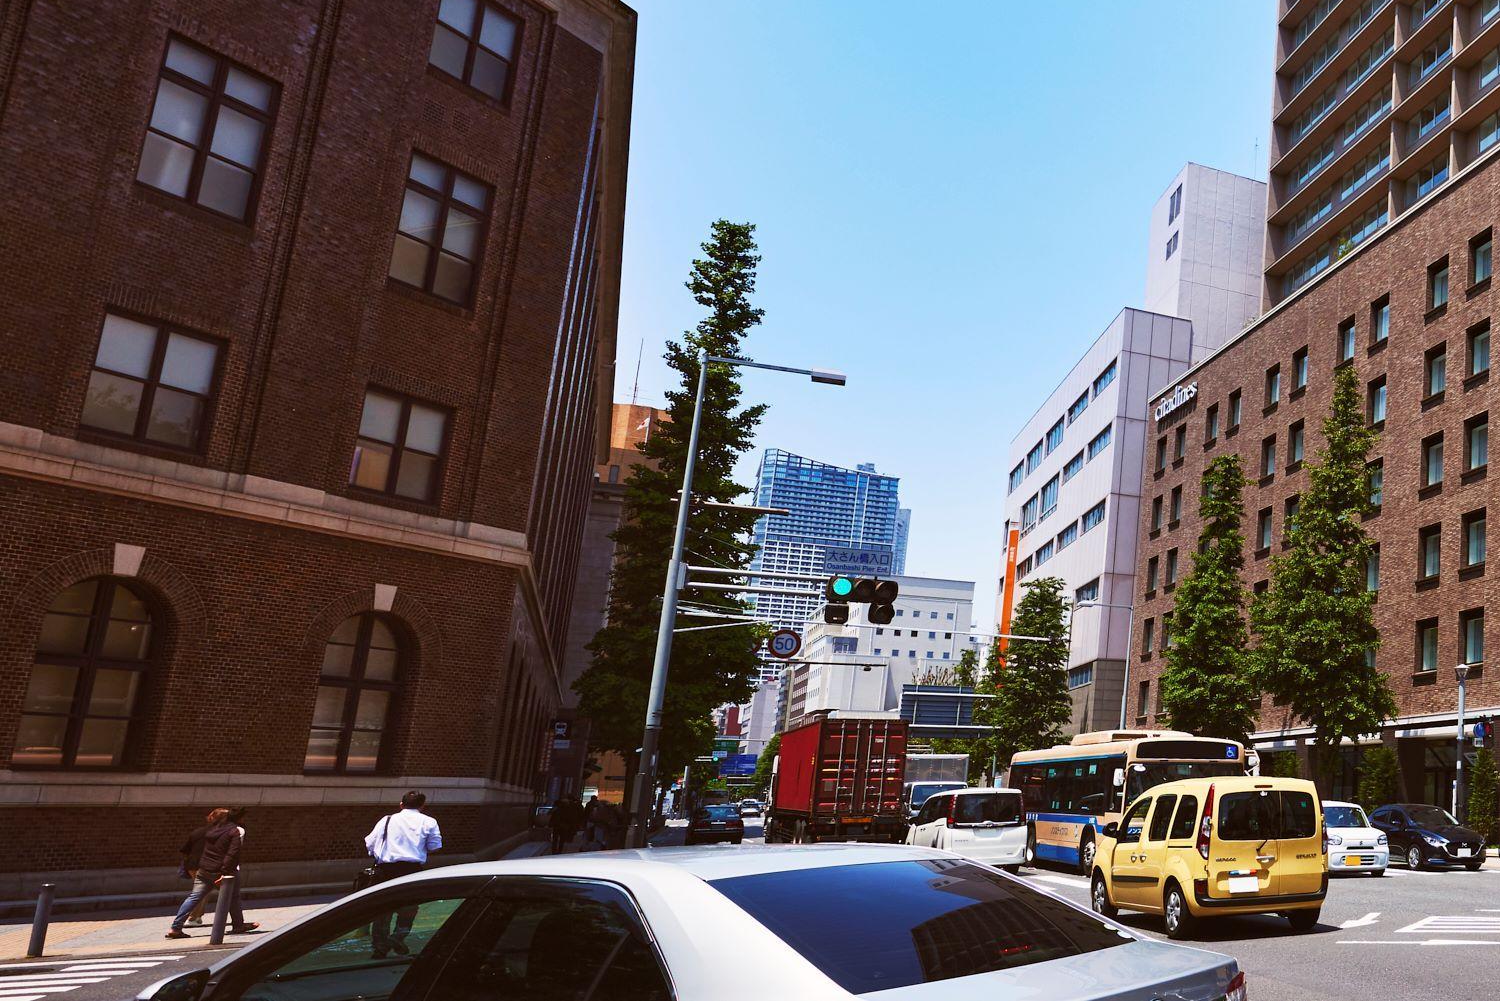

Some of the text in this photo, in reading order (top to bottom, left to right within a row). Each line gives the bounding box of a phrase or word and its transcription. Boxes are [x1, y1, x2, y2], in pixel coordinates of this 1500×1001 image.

[828, 551, 890, 565] 大さん橋入口
[827, 563, 860, 571] Osanbashi
[775, 637, 794, 650] 50
